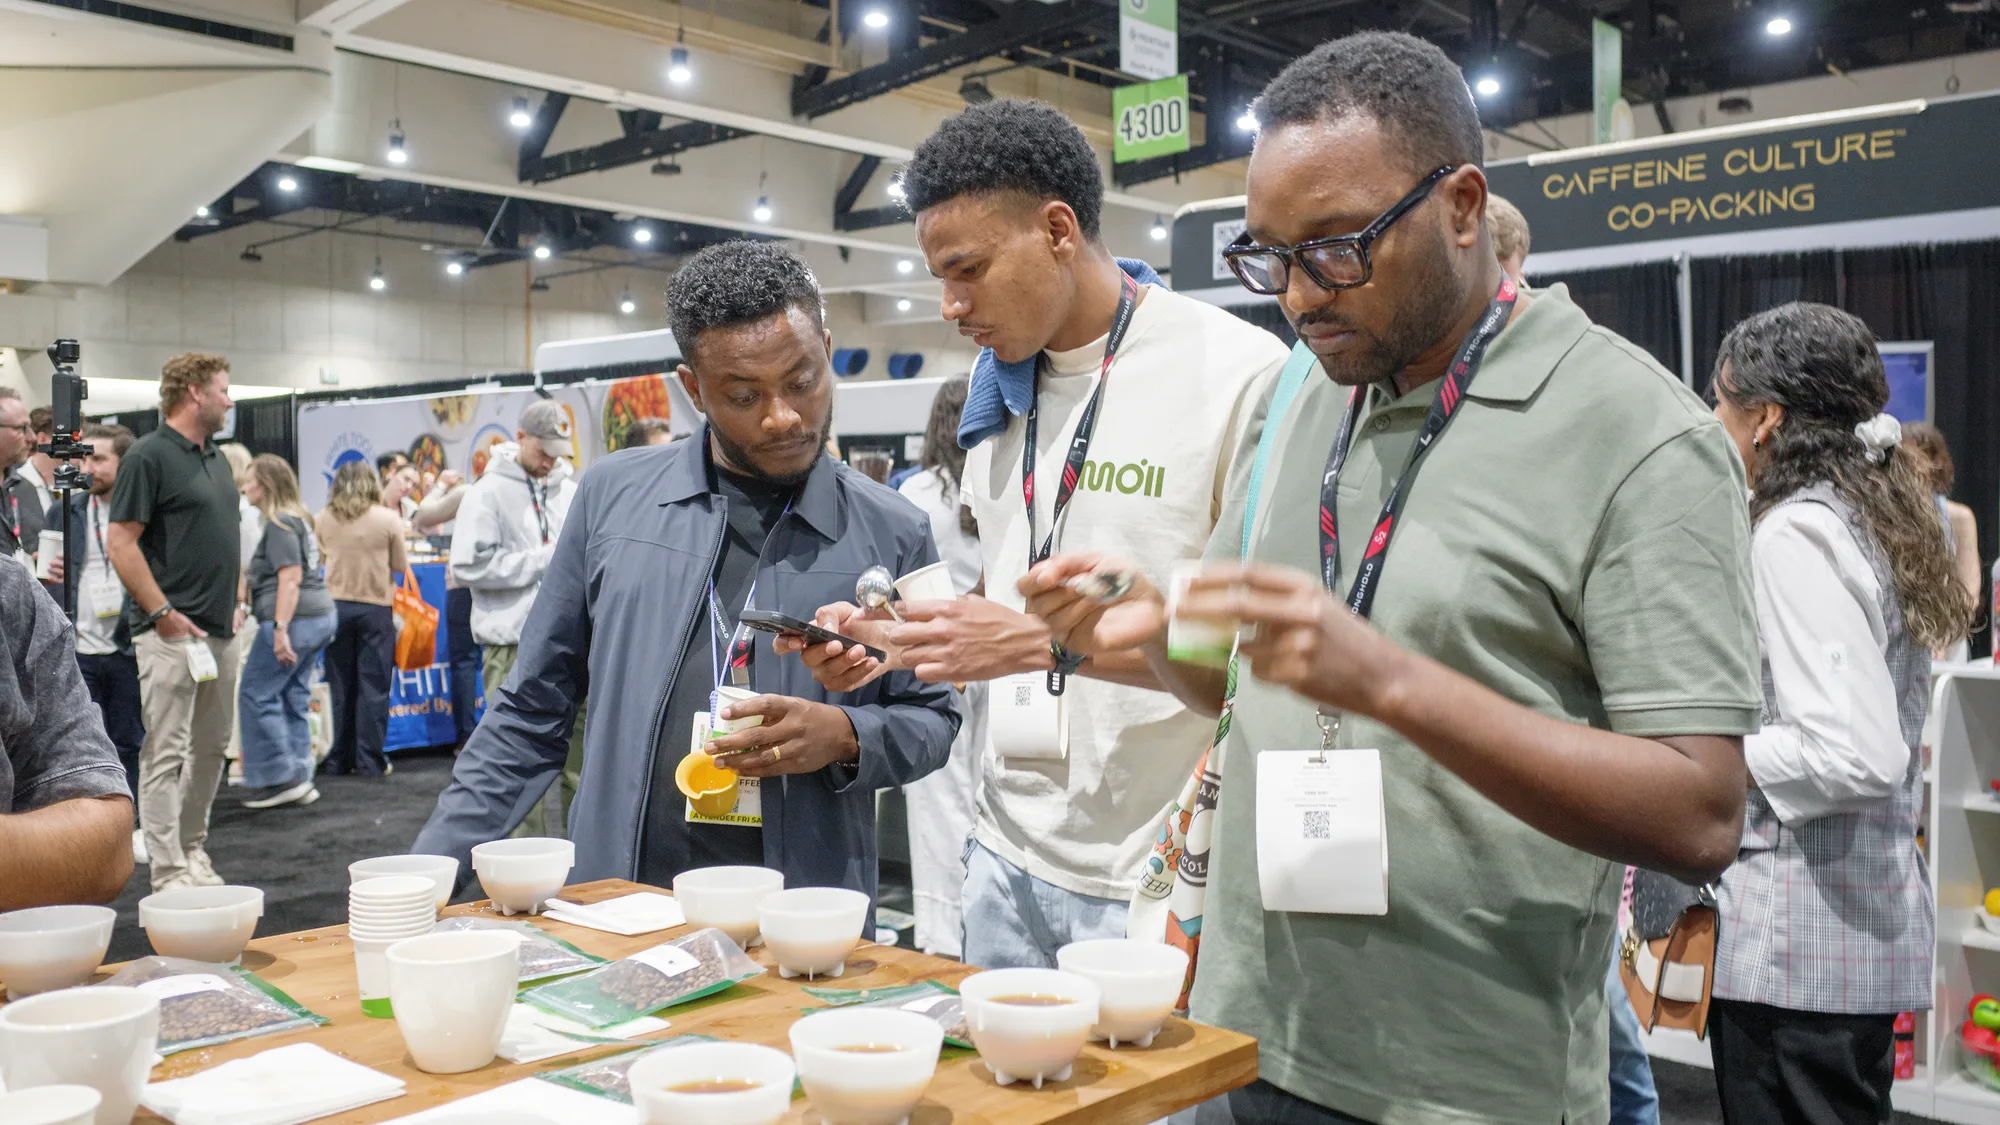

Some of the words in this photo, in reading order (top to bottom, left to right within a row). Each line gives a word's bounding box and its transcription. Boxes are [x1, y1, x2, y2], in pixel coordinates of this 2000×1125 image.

[1118, 98, 1183, 144] 4300
[1543, 152, 1708, 200] CAFFEINE
[1607, 183, 1816, 232] CO-PACKING
[1110, 300, 1132, 351] STRONGHOLD
[1462, 306, 1503, 363] STRONGHOLD
[389, 662, 451, 698] HIT
[736, 815, 750, 823] FRI
[751, 816, 762, 824] SA
[1180, 852, 1207, 874] COL
